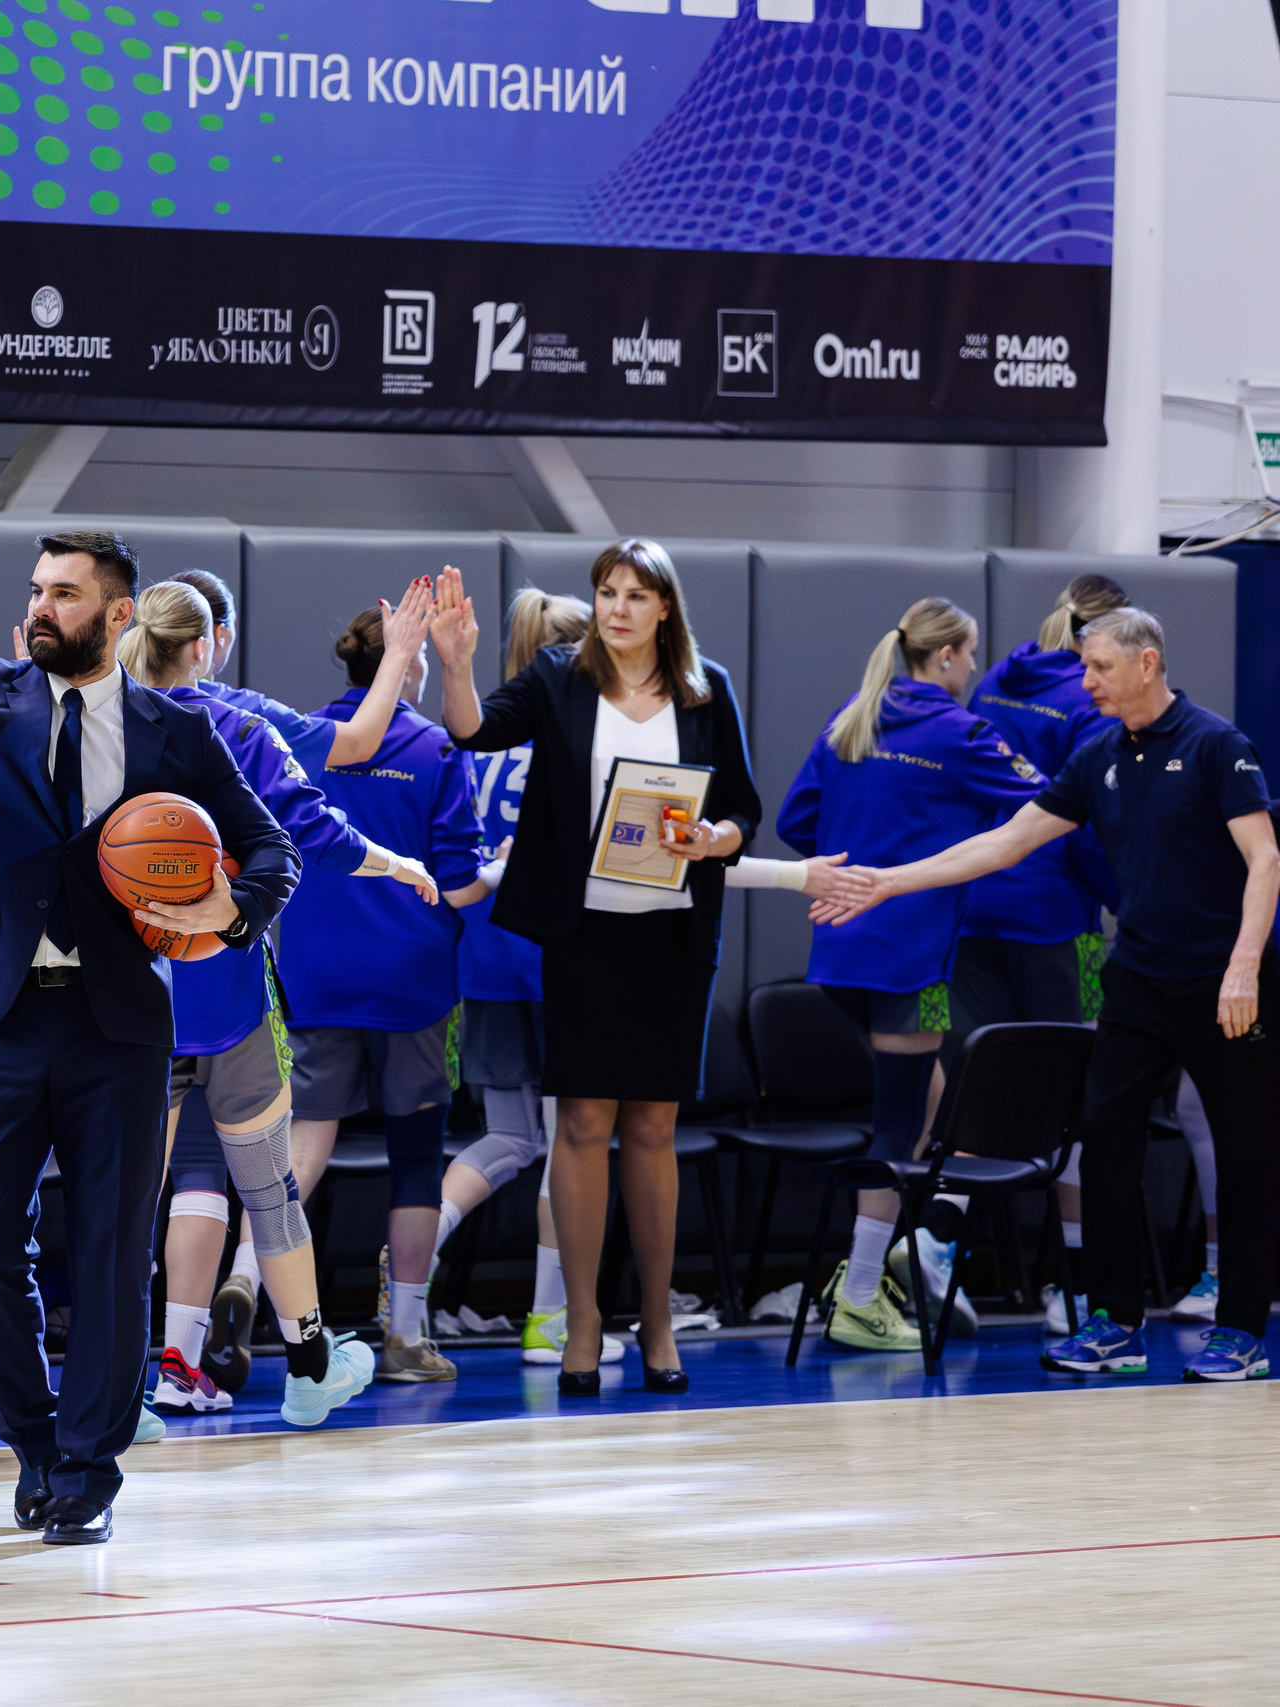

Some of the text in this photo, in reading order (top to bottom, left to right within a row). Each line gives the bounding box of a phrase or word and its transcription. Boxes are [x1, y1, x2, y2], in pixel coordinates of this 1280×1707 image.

[161, 44, 627, 116] группа компаний
[217, 306, 293, 335] ЦВЕТЫ
[166, 337, 292, 365] ЯБЛОНЬКИ
[472, 301, 527, 390] 12
[723, 334, 770, 374] БК
[813, 332, 920, 380] Om1.ru
[995, 334, 1070, 362] РАДИО
[993, 362, 1078, 388] СИБИРЬ
[147, 863, 200, 875] JB-1000
